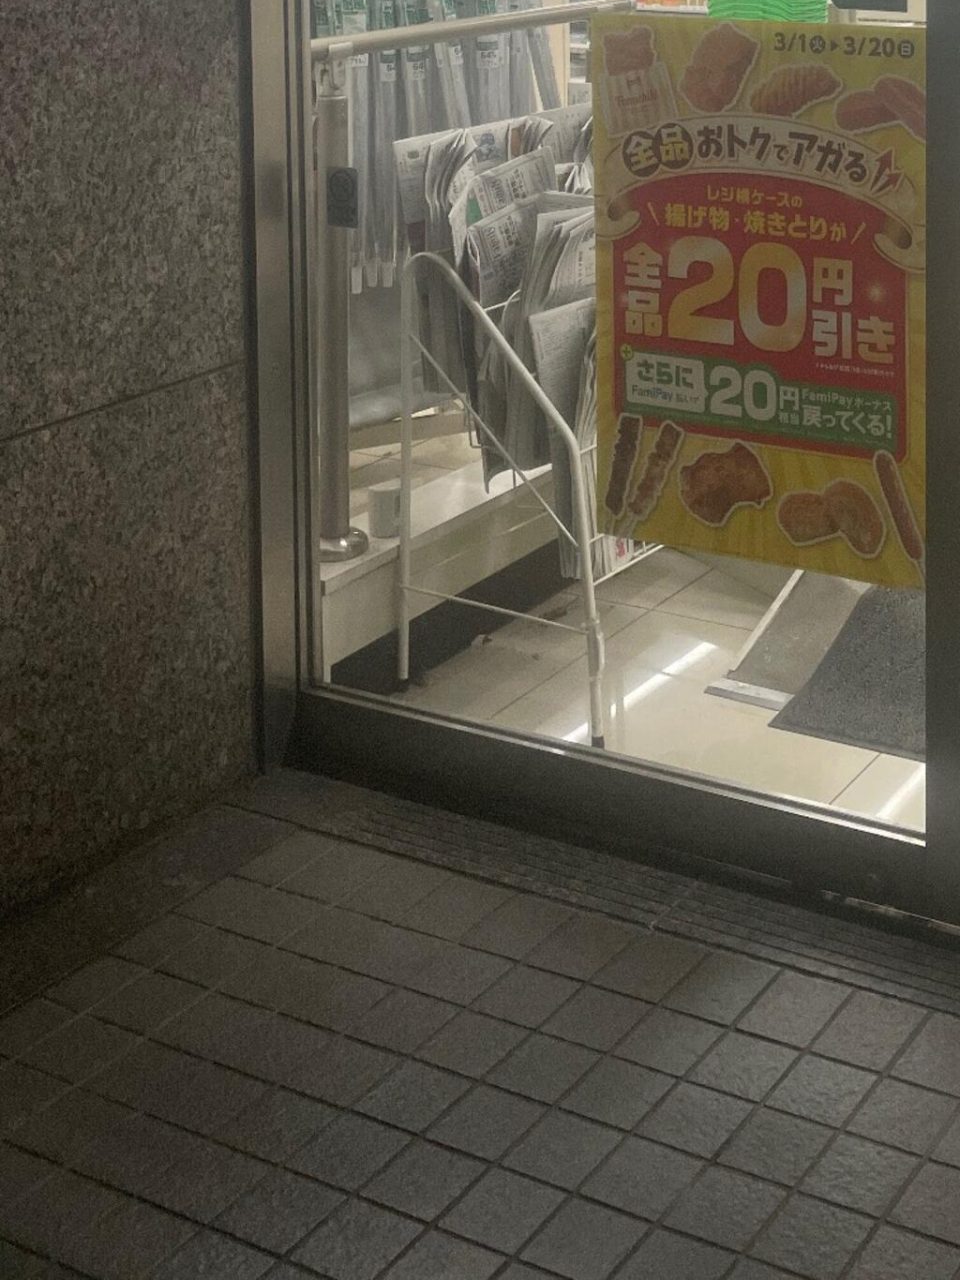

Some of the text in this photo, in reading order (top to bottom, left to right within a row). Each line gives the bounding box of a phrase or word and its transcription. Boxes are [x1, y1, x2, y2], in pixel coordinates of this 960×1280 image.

[623, 242, 663, 337] 全品
[667, 235, 807, 352] 20
[636, 359, 697, 390] さらに
[709, 365, 778, 421] 20
